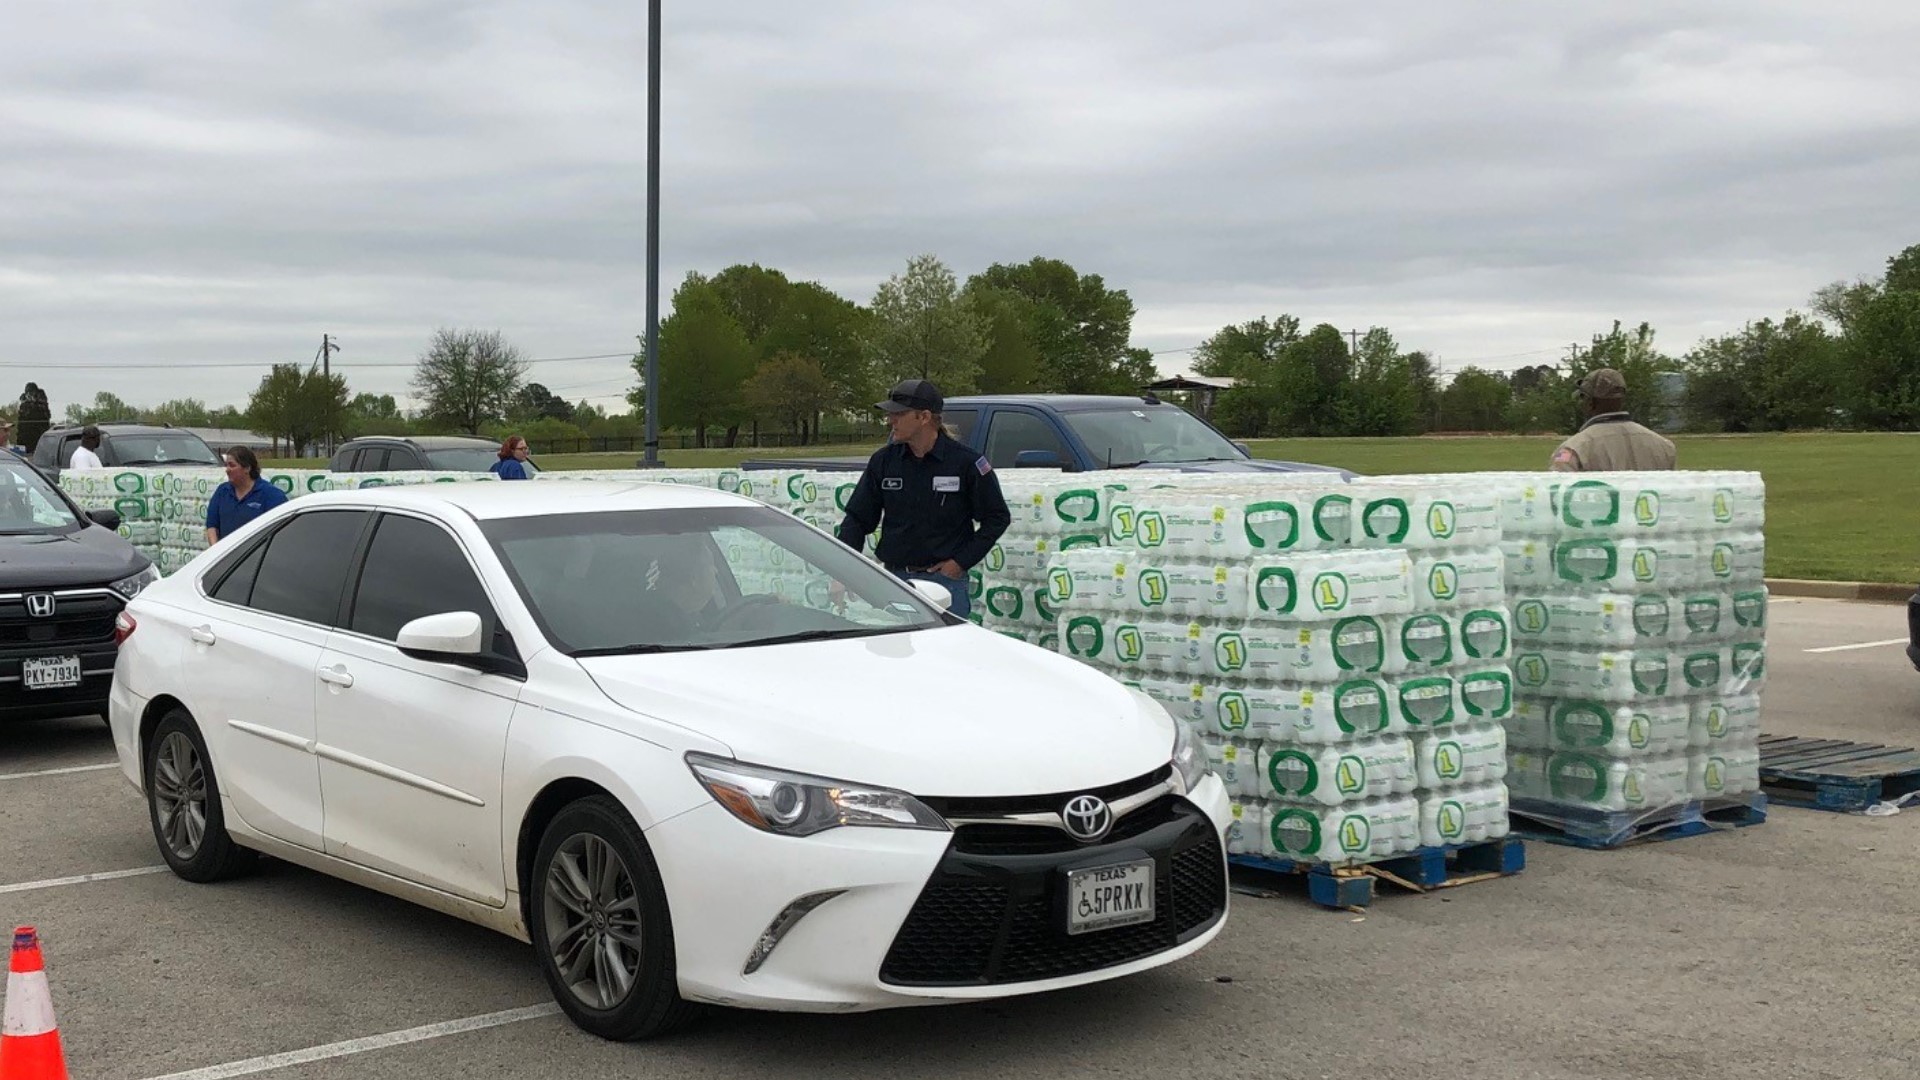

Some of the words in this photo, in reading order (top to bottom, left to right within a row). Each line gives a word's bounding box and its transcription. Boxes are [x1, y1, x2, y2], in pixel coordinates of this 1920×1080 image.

[1117, 511, 1132, 534] 1
[1144, 518, 1159, 542] 1
[1054, 573, 1068, 596] 1
[1146, 576, 1161, 600] 1
[1319, 579, 1338, 605] 1
[1122, 631, 1138, 656] 1
[1223, 640, 1240, 665] 1
[1225, 699, 1243, 725] 1
[1094, 868, 1127, 882] TEXAS
